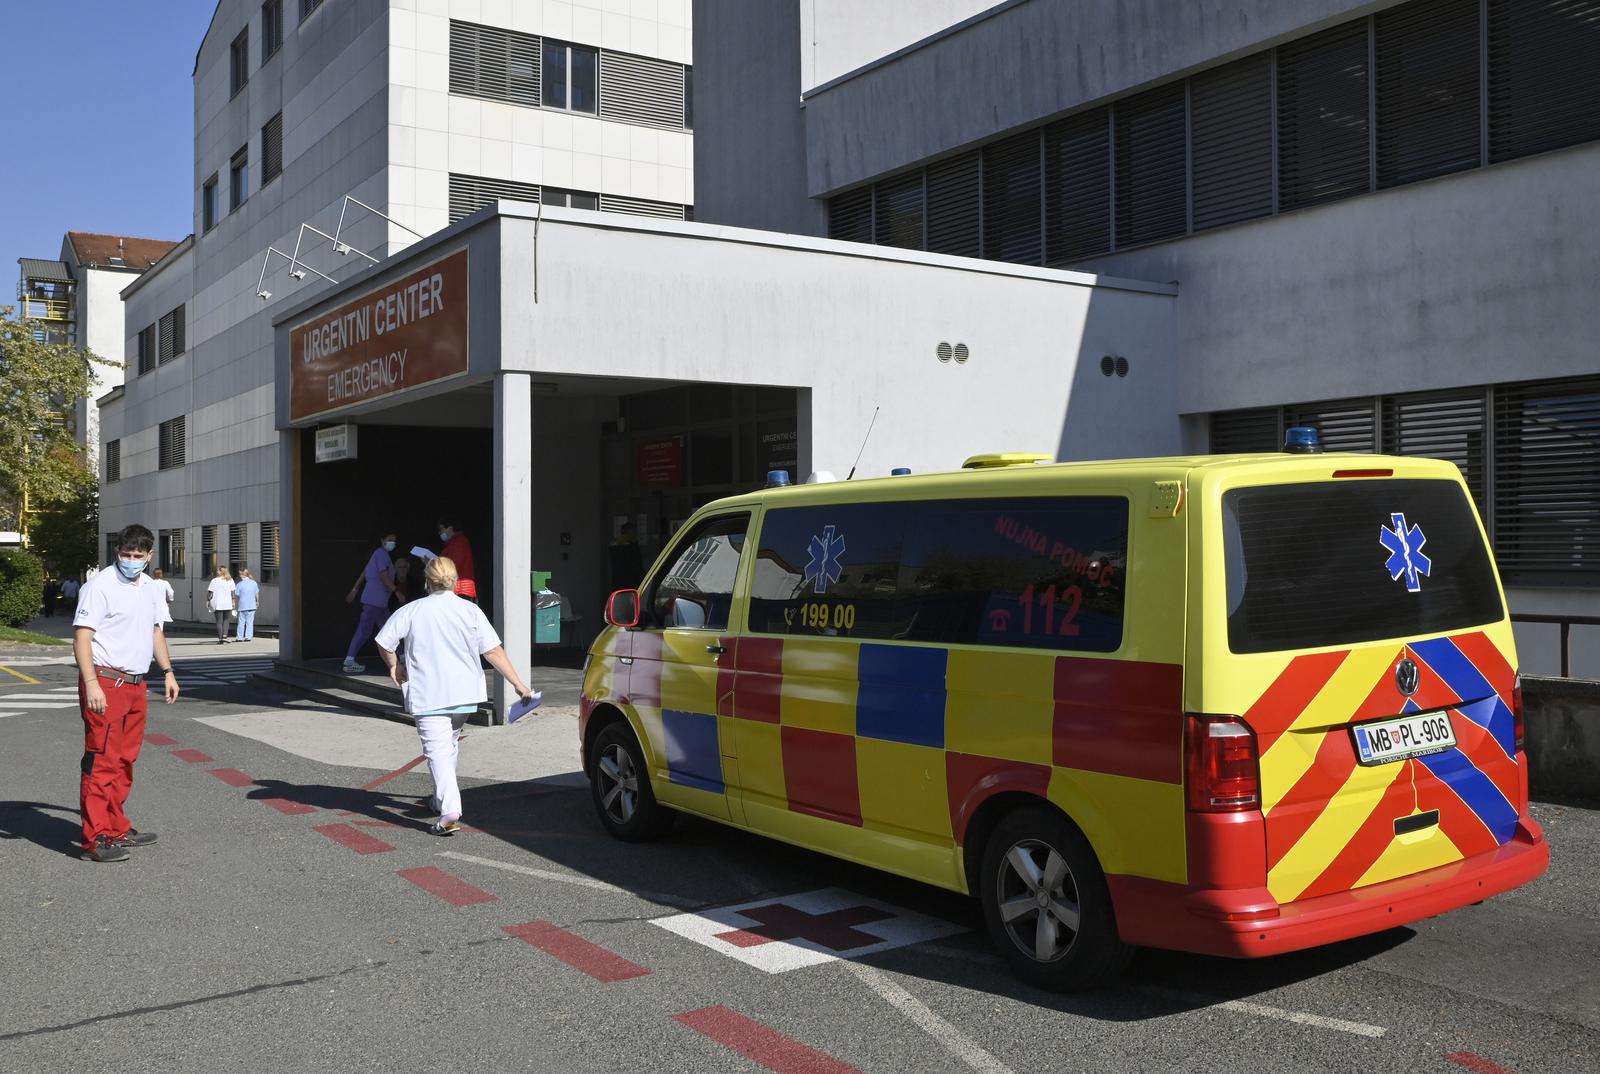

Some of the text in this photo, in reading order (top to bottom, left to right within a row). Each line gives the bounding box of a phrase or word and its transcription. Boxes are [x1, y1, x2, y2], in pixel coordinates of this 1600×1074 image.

[303, 272, 444, 363] URGENTNI CENTER
[328, 348, 408, 403] EMERGENCY
[993, 513, 1047, 556] NUJNA
[800, 602, 856, 630] 199 00
[1018, 583, 1082, 636] 112
[1367, 717, 1449, 753] MB PL-906
[1380, 747, 1444, 764] PORSCHE MARIBOR
